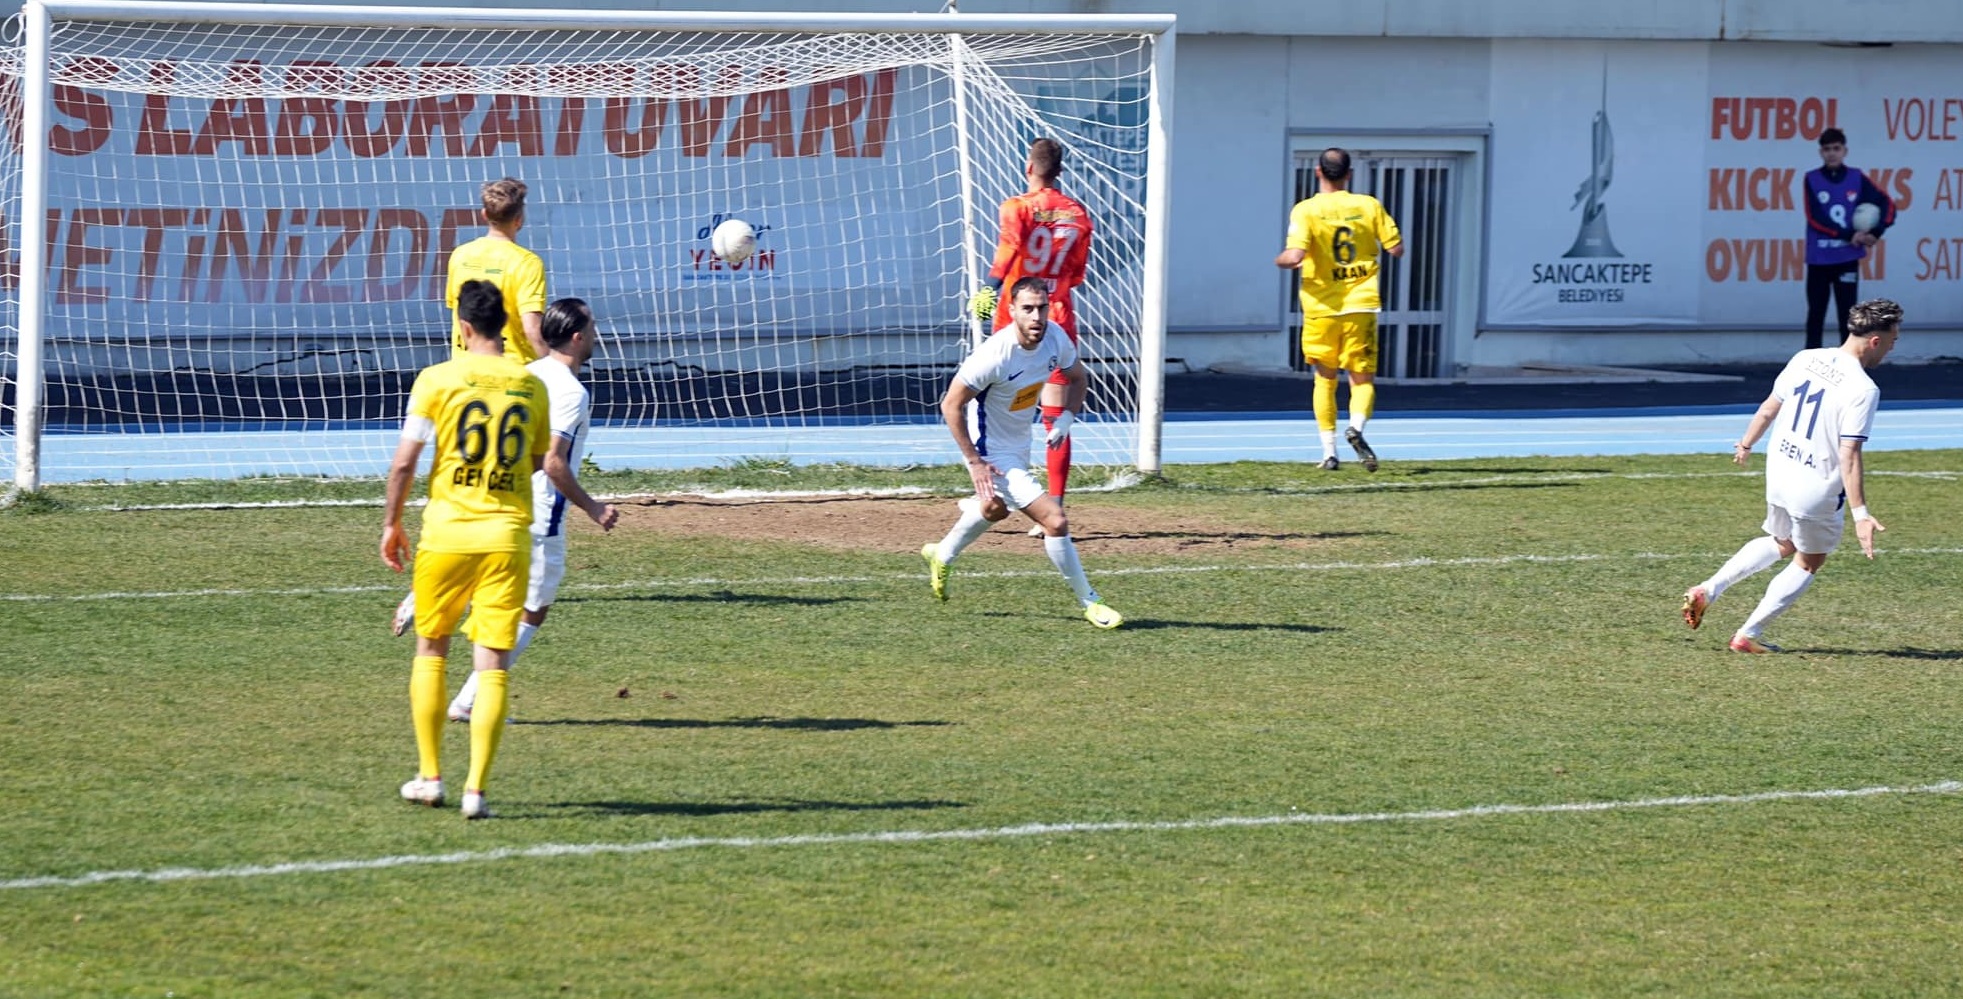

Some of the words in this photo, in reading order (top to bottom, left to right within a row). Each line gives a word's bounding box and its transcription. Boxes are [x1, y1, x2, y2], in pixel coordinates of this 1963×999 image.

[1711, 96, 1842, 140] FUTBOL
[1708, 168, 1795, 211] KICK
[1023, 224, 1079, 275] 97
[1333, 226, 1356, 265] 6
[1705, 237, 1885, 282] OYUNRI
[1332, 265, 1368, 281] KAAN
[1532, 263, 1652, 284] SANCAKTEPE
[1792, 378, 1826, 441] 11
[456, 399, 530, 469] 66
